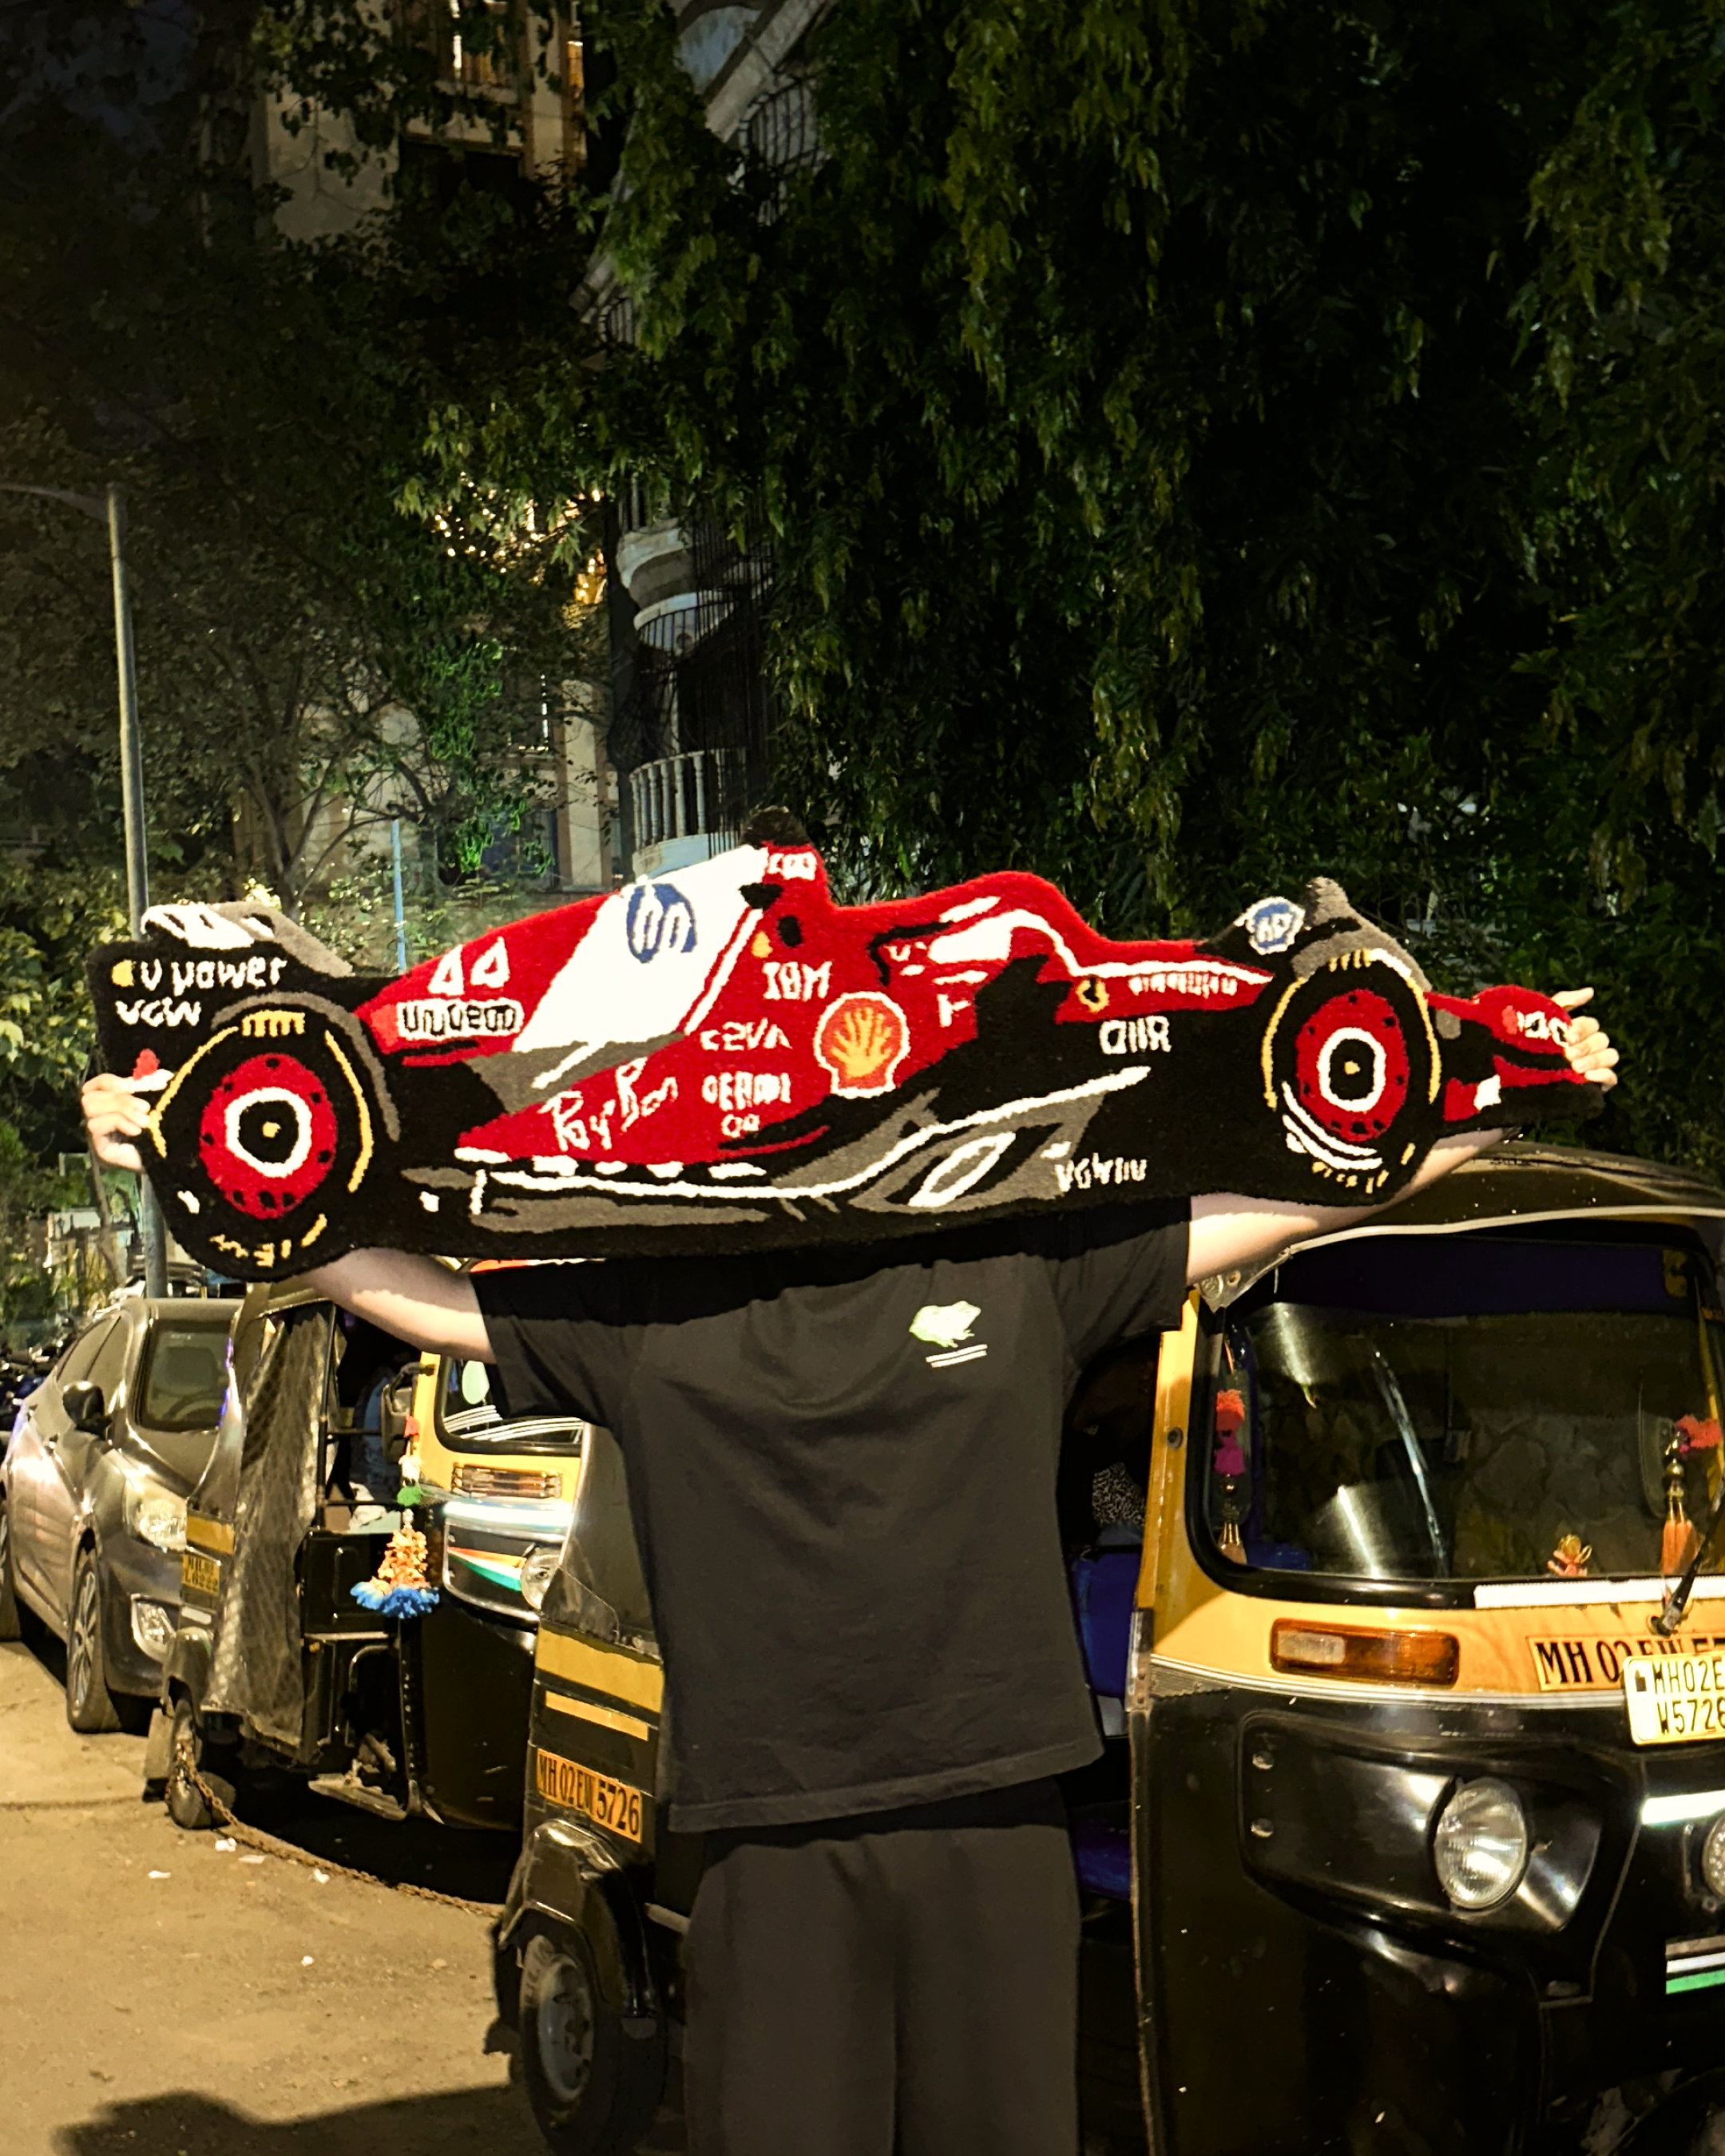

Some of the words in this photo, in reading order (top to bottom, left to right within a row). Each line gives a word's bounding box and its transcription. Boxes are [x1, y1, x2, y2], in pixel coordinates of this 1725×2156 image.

[427, 936, 510, 997] 44
[762, 961, 833, 1002] IBM
[1534, 1639, 1594, 1686] MH
